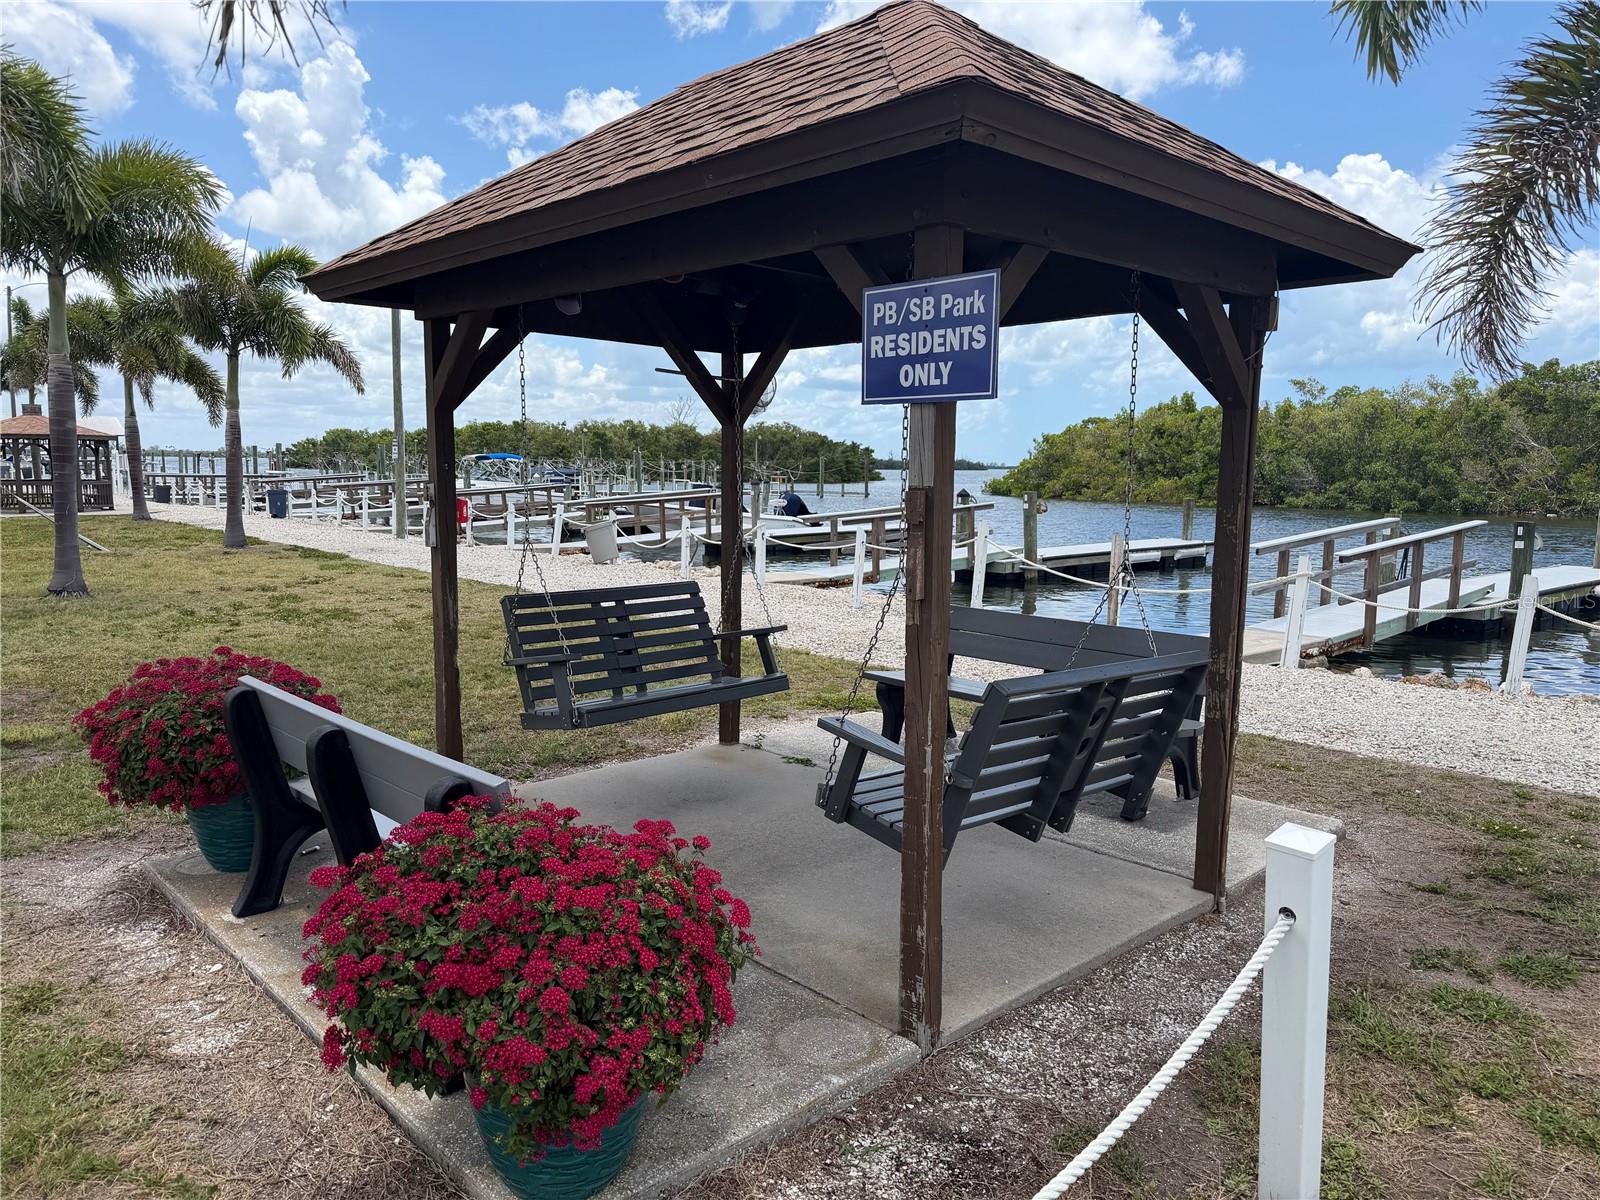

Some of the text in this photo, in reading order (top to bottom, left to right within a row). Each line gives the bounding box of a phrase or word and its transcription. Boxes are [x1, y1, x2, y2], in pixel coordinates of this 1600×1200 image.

[873, 289, 986, 326] PB/SB Park
[870, 324, 986, 358] RESIDENTS
[899, 361, 953, 387] ONLY
